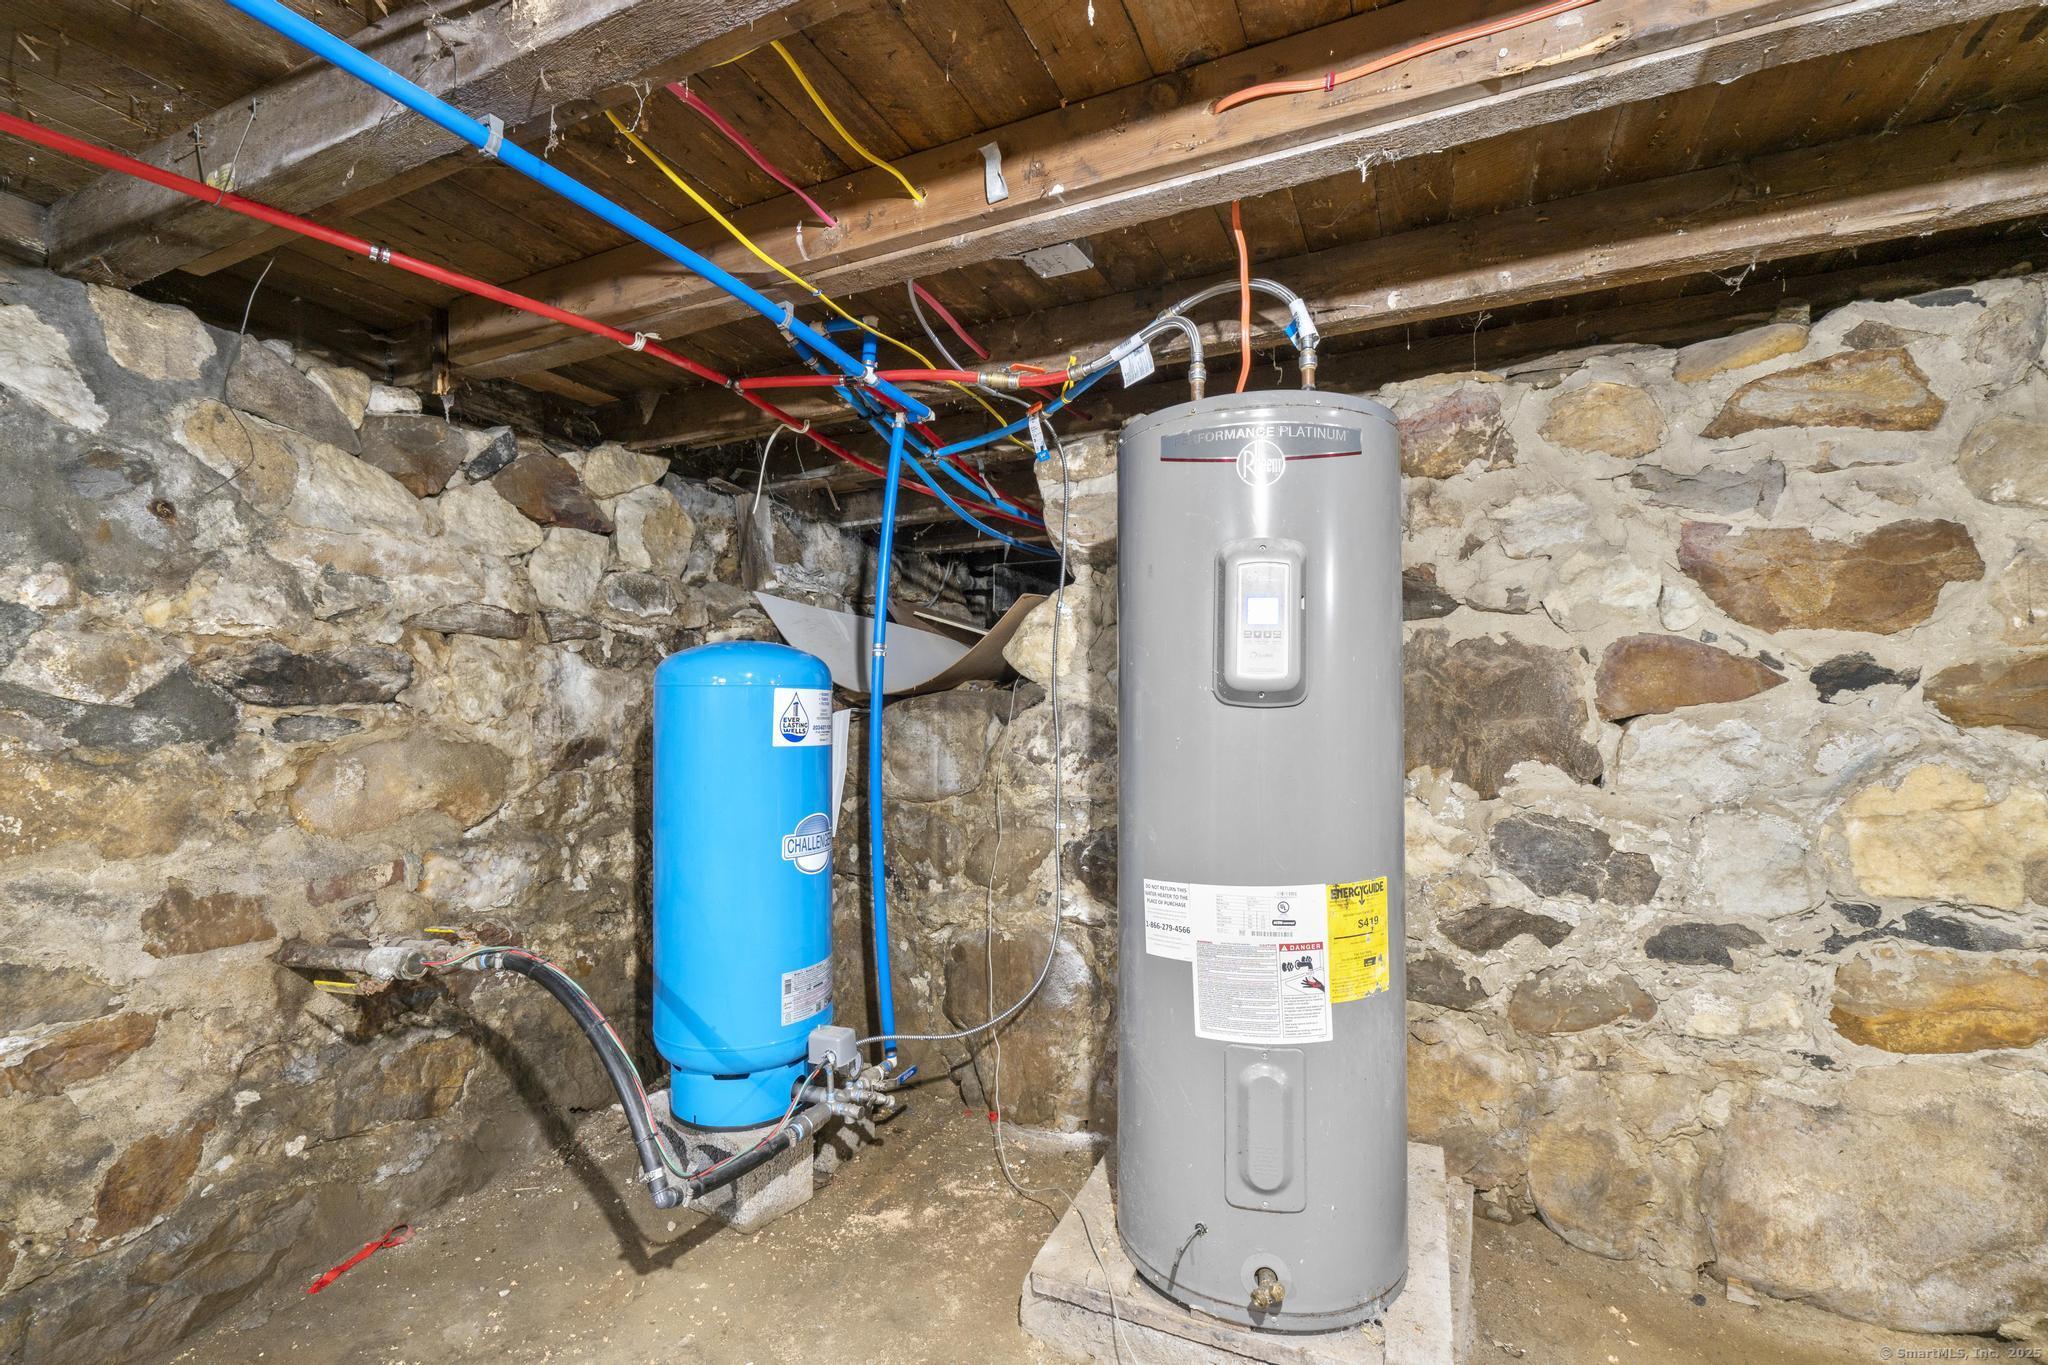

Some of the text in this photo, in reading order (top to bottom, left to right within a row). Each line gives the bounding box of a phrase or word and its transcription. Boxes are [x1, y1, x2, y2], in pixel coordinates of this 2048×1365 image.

[1177, 425, 1347, 447] FORMANCE PLATINUM
[787, 832, 831, 854] CHALLENGE
[1145, 920, 1191, 934] 1-866-279-4566
[1289, 943, 1321, 951] DANGER
